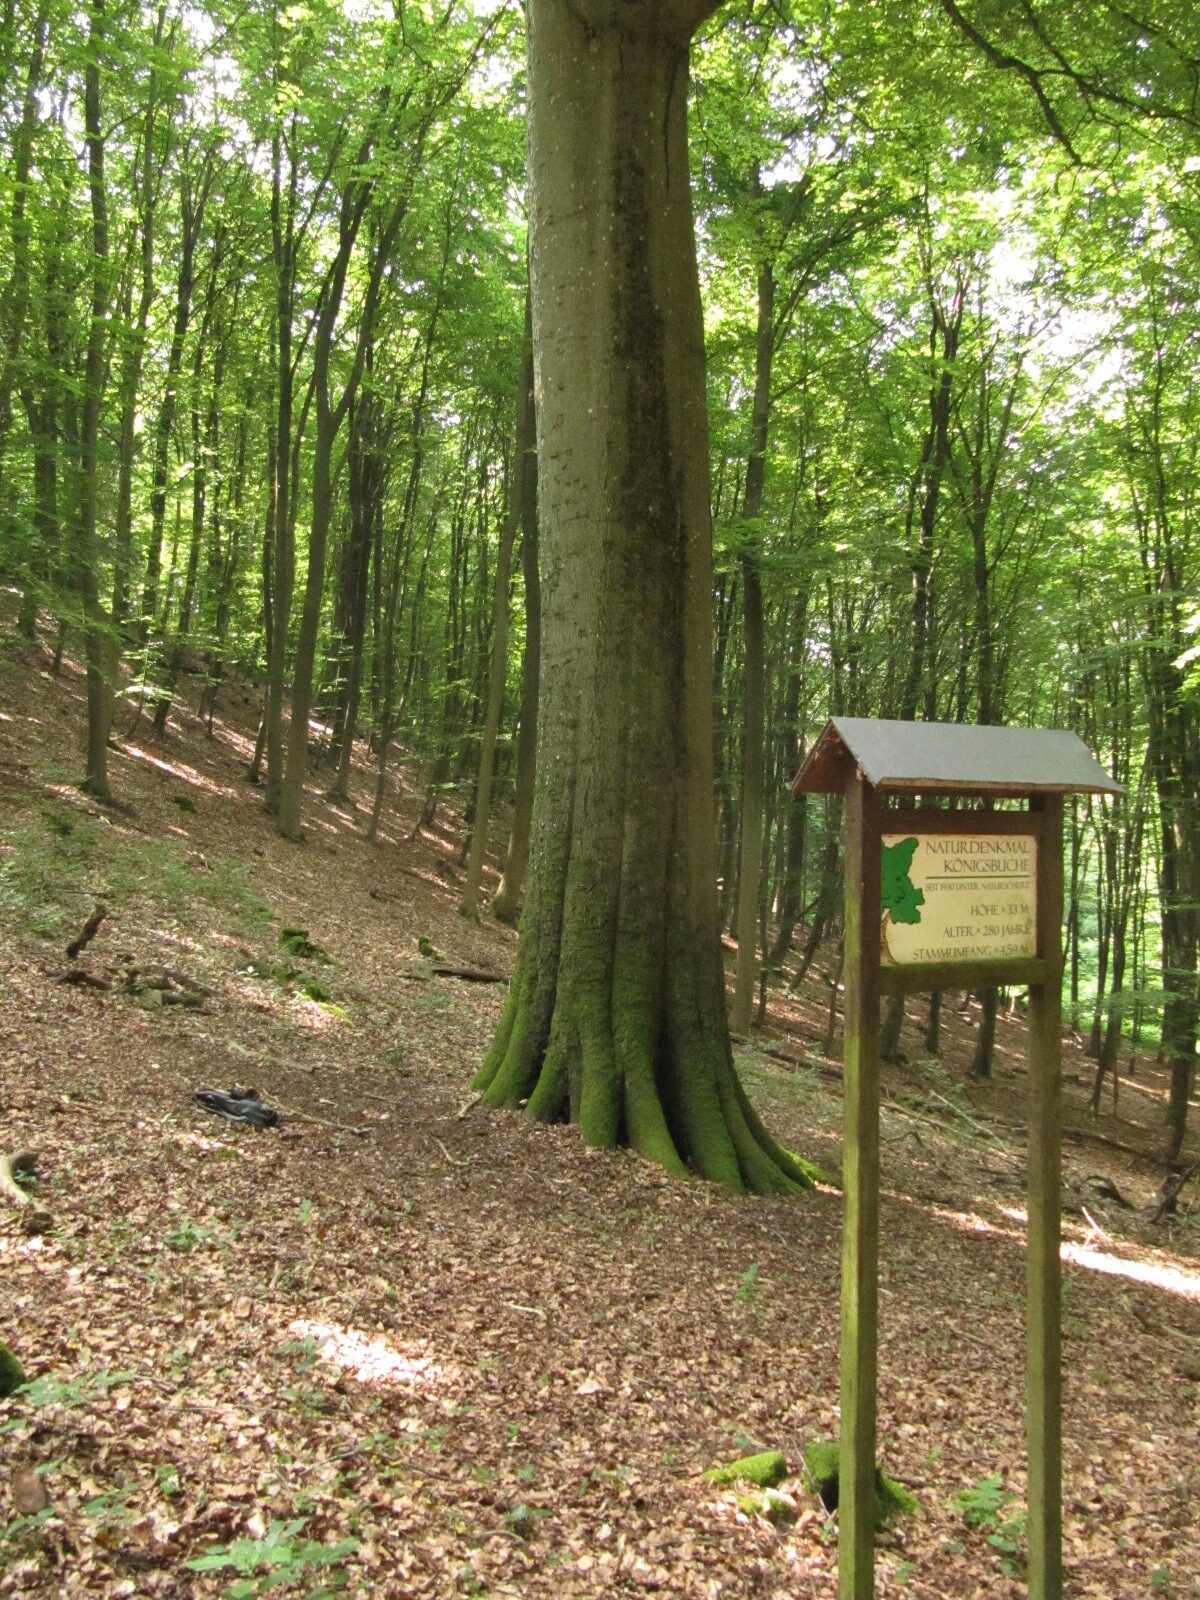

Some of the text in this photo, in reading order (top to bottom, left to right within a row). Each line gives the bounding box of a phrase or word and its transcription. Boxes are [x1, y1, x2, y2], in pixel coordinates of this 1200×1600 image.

[926, 841, 1030, 854] NATURDENKMAL
[944, 858, 1030, 873] KÖNIGSBUCHE
[956, 882, 979, 890] UNTER
[971, 904, 999, 915] HÖHE
[943, 923, 1032, 937] ALTER 280 JAHRE
[913, 946, 992, 959] STAMMUMFANG
